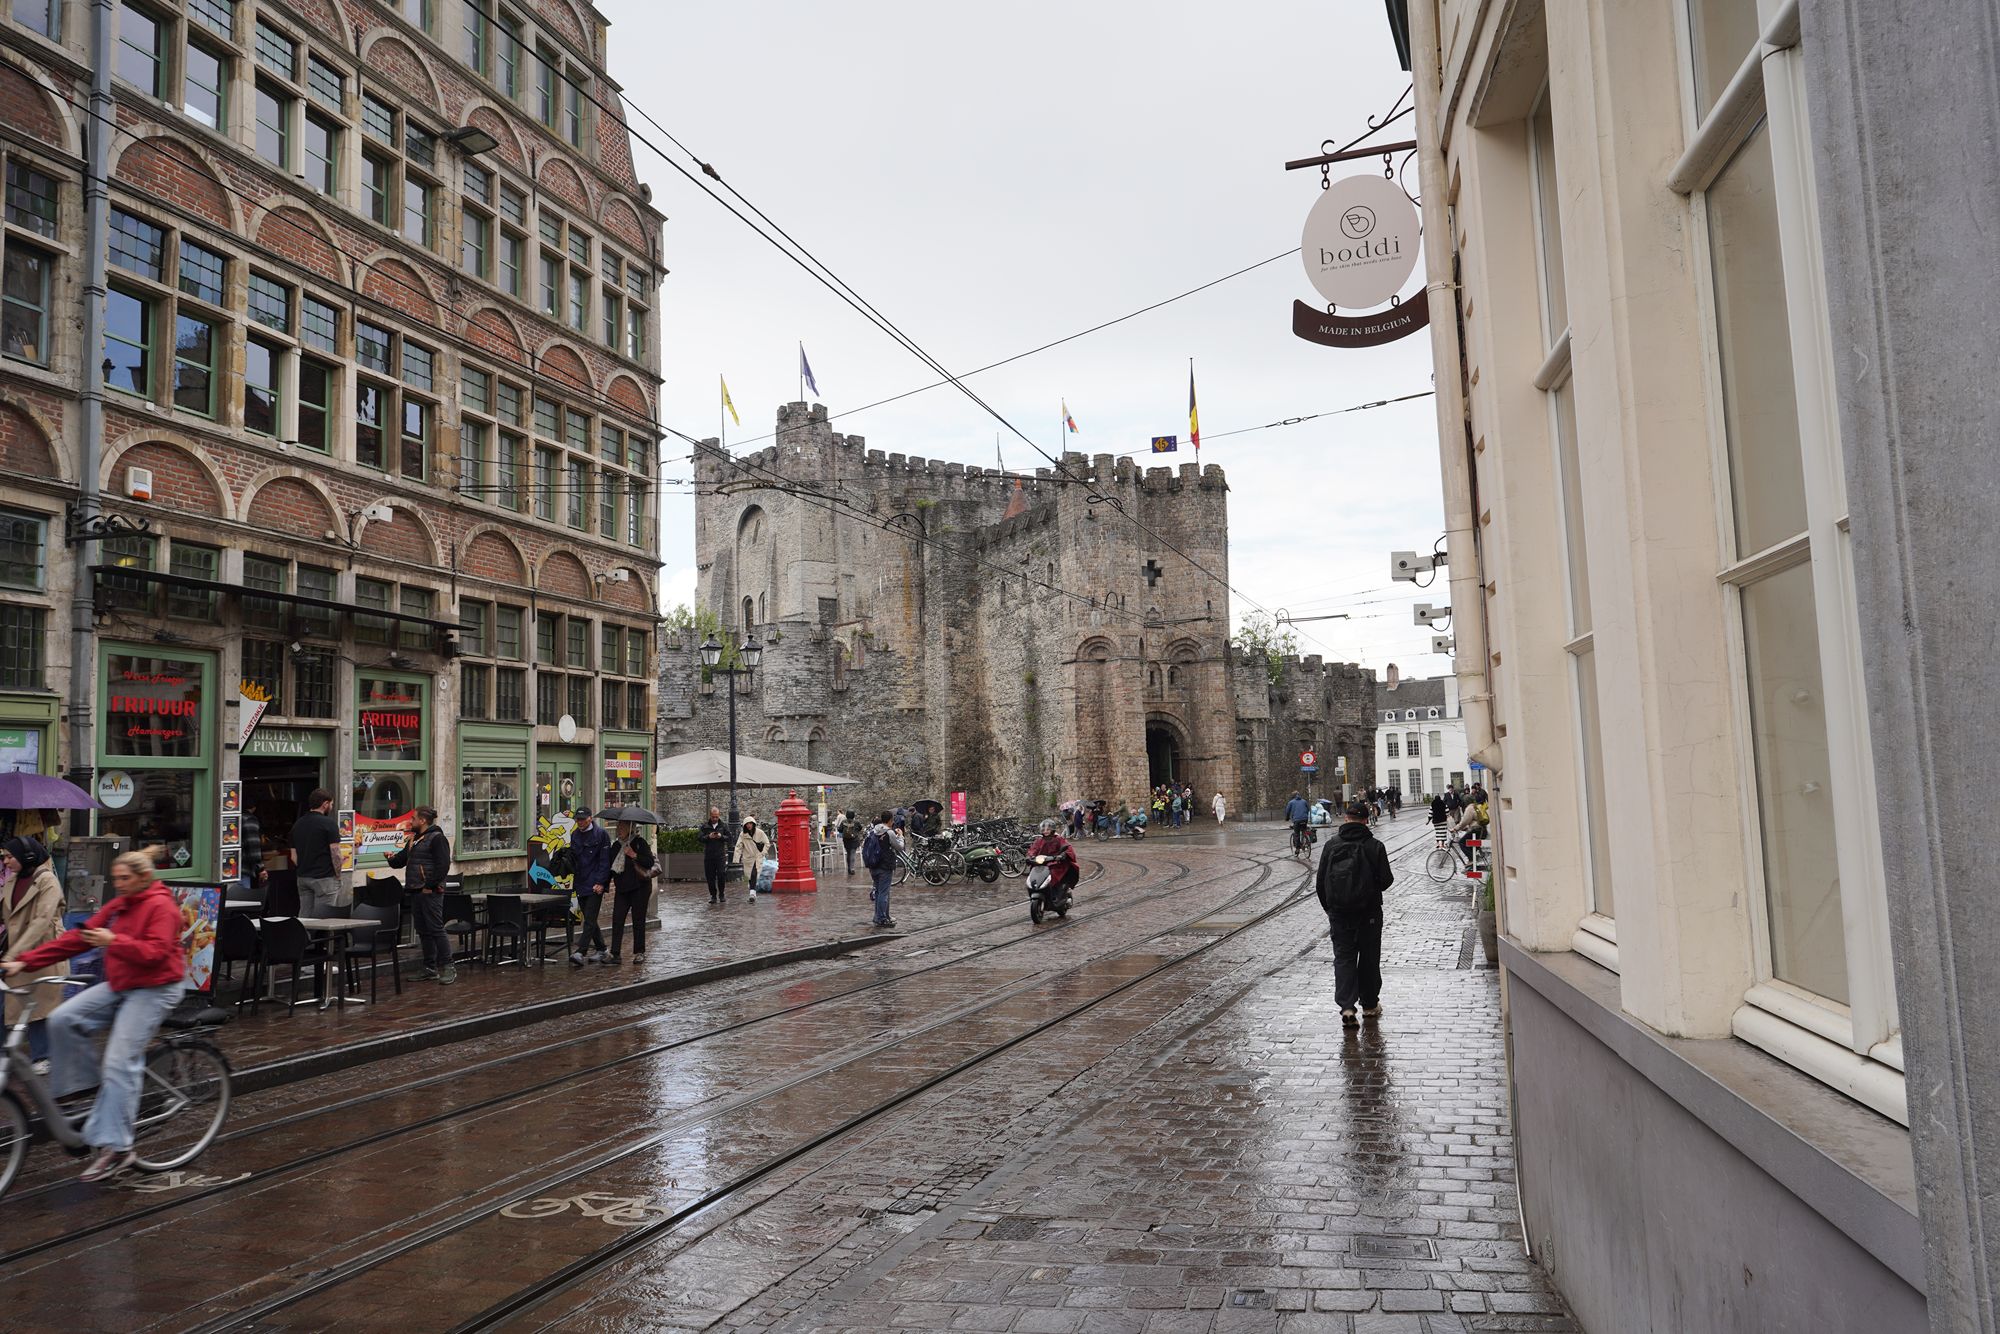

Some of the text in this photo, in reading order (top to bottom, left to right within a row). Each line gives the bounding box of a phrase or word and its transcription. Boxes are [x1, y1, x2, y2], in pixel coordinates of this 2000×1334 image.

[1320, 236, 1401, 265] boddi
[1319, 315, 1412, 336] MADE IN BELGIUM
[111, 695, 196, 718] FRITUUR
[362, 712, 419, 729] FRITUUR
[253, 728, 293, 741] RIETEN
[253, 741, 304, 753] PUNTZAK
[607, 760, 628, 769] BELGIAN
[536, 871, 551, 880] OPEN
